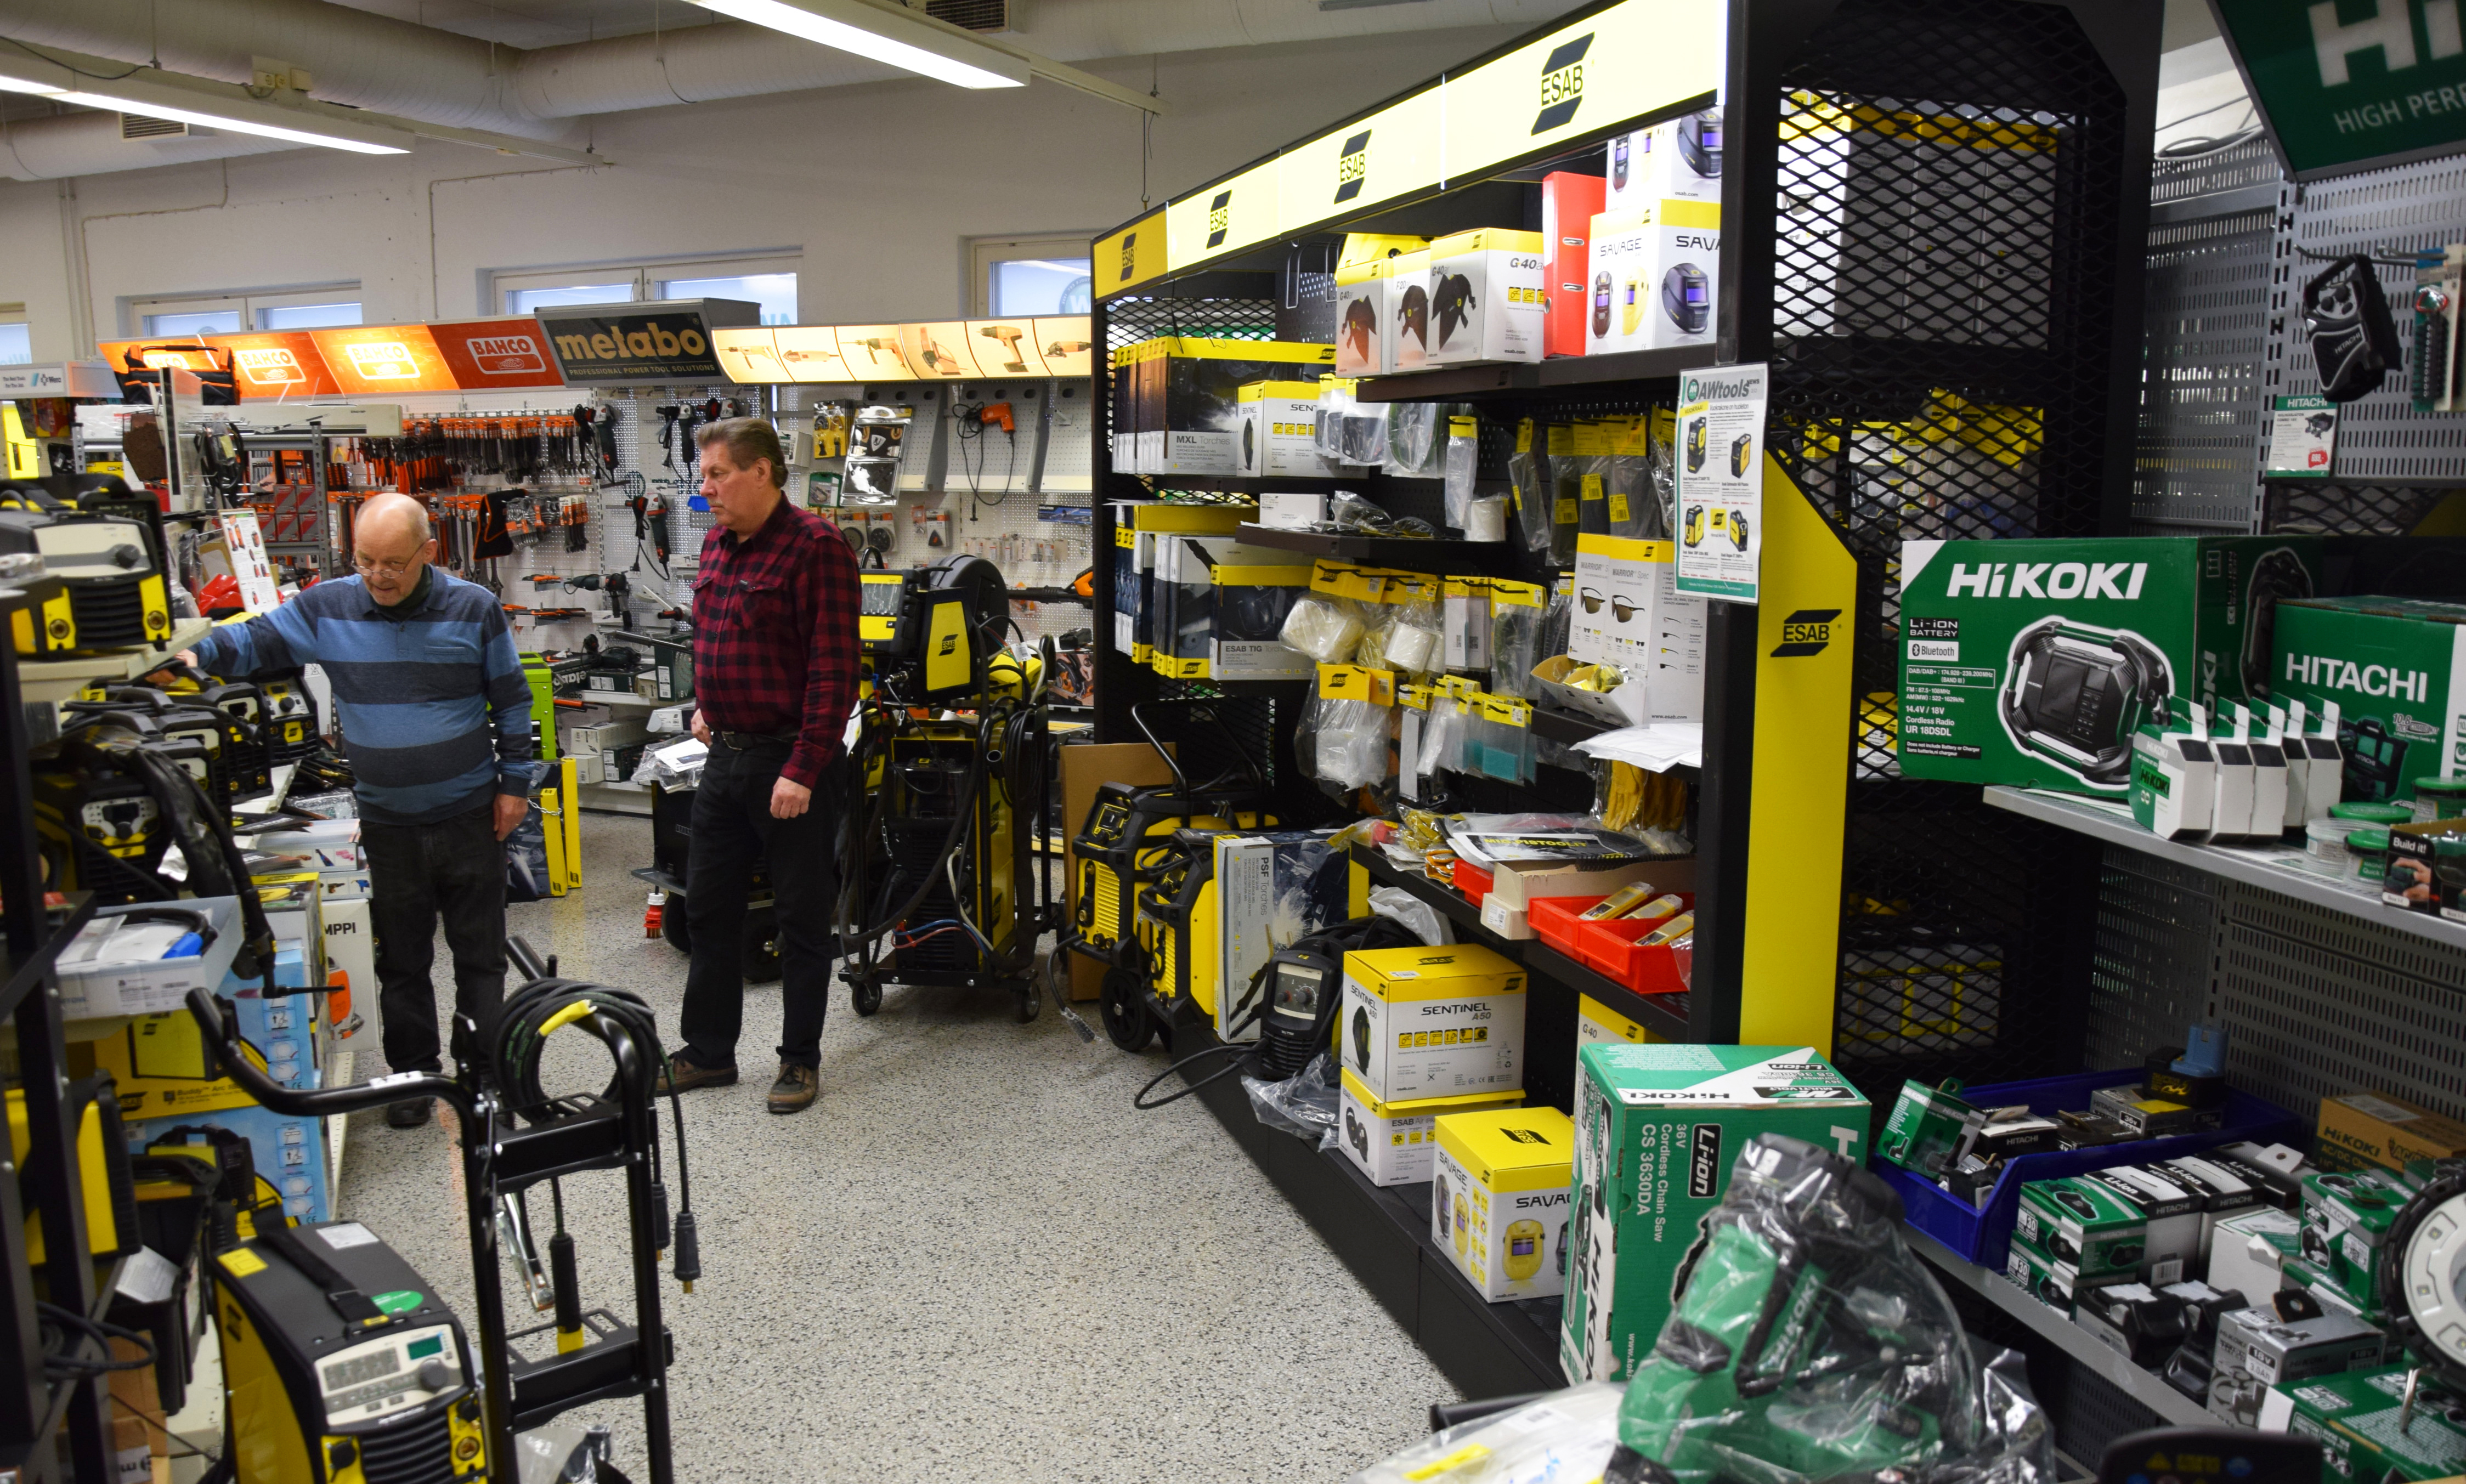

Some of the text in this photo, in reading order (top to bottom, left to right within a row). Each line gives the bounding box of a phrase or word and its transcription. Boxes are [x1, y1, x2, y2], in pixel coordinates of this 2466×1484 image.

[1542, 65, 1583, 105] ESAB
[2334, 99, 2403, 134] HIGH
[1340, 154, 1366, 182] ESAB
[1209, 206, 1228, 232] ESAB
[1600, 237, 1642, 257] SAVAGE
[1122, 247, 1135, 268] ESAB
[471, 339, 531, 355] BAHCO
[555, 322, 705, 360] metabo
[2335, 332, 2361, 355] HITACHI
[242, 352, 292, 366] BAHCO
[353, 345, 405, 360] BAHCO
[569, 367, 621, 375] PROFESSIONAL
[672, 364, 715, 372] SOLUTIONS
[1698, 379, 1749, 400] AWtools
[1200, 437, 1230, 445] Torches
[1947, 562, 2147, 599] HiKOKI
[1783, 625, 1829, 642] ESAB
[1921, 646, 1954, 656] Bluetooth
[2286, 653, 2428, 703] HITACHI
[1905, 716, 1934, 724] Cordless
[1905, 726, 1952, 737] UR 18DSDL
[2146, 741, 2168, 758] HiKOKI
[2355, 754, 2375, 766] HITACHI
[2141, 769, 2169, 795] HiKOKI
[1484, 839, 1587, 847] MIG-PISTOOLIT
[2393, 837, 2427, 854] Build it!
[2363, 868, 2380, 876] Quick
[1260, 857, 1269, 915] PSF Torches
[1351, 985, 1377, 1011] SENTINEL
[1422, 1003, 1491, 1015] SENTINEL
[2094, 1099, 2119, 1115] HITACHI
[1514, 1129, 1537, 1144] ESAB
[1676, 1124, 1687, 1148] 36V
[2007, 1135, 2038, 1146] HITACHI
[2324, 1126, 2381, 1157] HiKOKI
[1439, 1151, 1467, 1187] SAVAGE
[1637, 1124, 1656, 1215] CS 3630DA
[1695, 1128, 1715, 1194] Li-ion
[2212, 1159, 2244, 1177] HITACHI
[2150, 1170, 2182, 1185] HITACHI
[2168, 1166, 2202, 1185] Li-ion
[2229, 1162, 2265, 1178] Li-ion
[1654, 1124, 1672, 1242] Cordless Chain Saw
[2105, 1177, 2138, 1194] Li-ion
[2157, 1203, 2190, 1215] HITACHI
[2220, 1196, 2253, 1207] HITACHI
[2027, 1216, 2035, 1229] 30
[2019, 1261, 2028, 1274] 30
